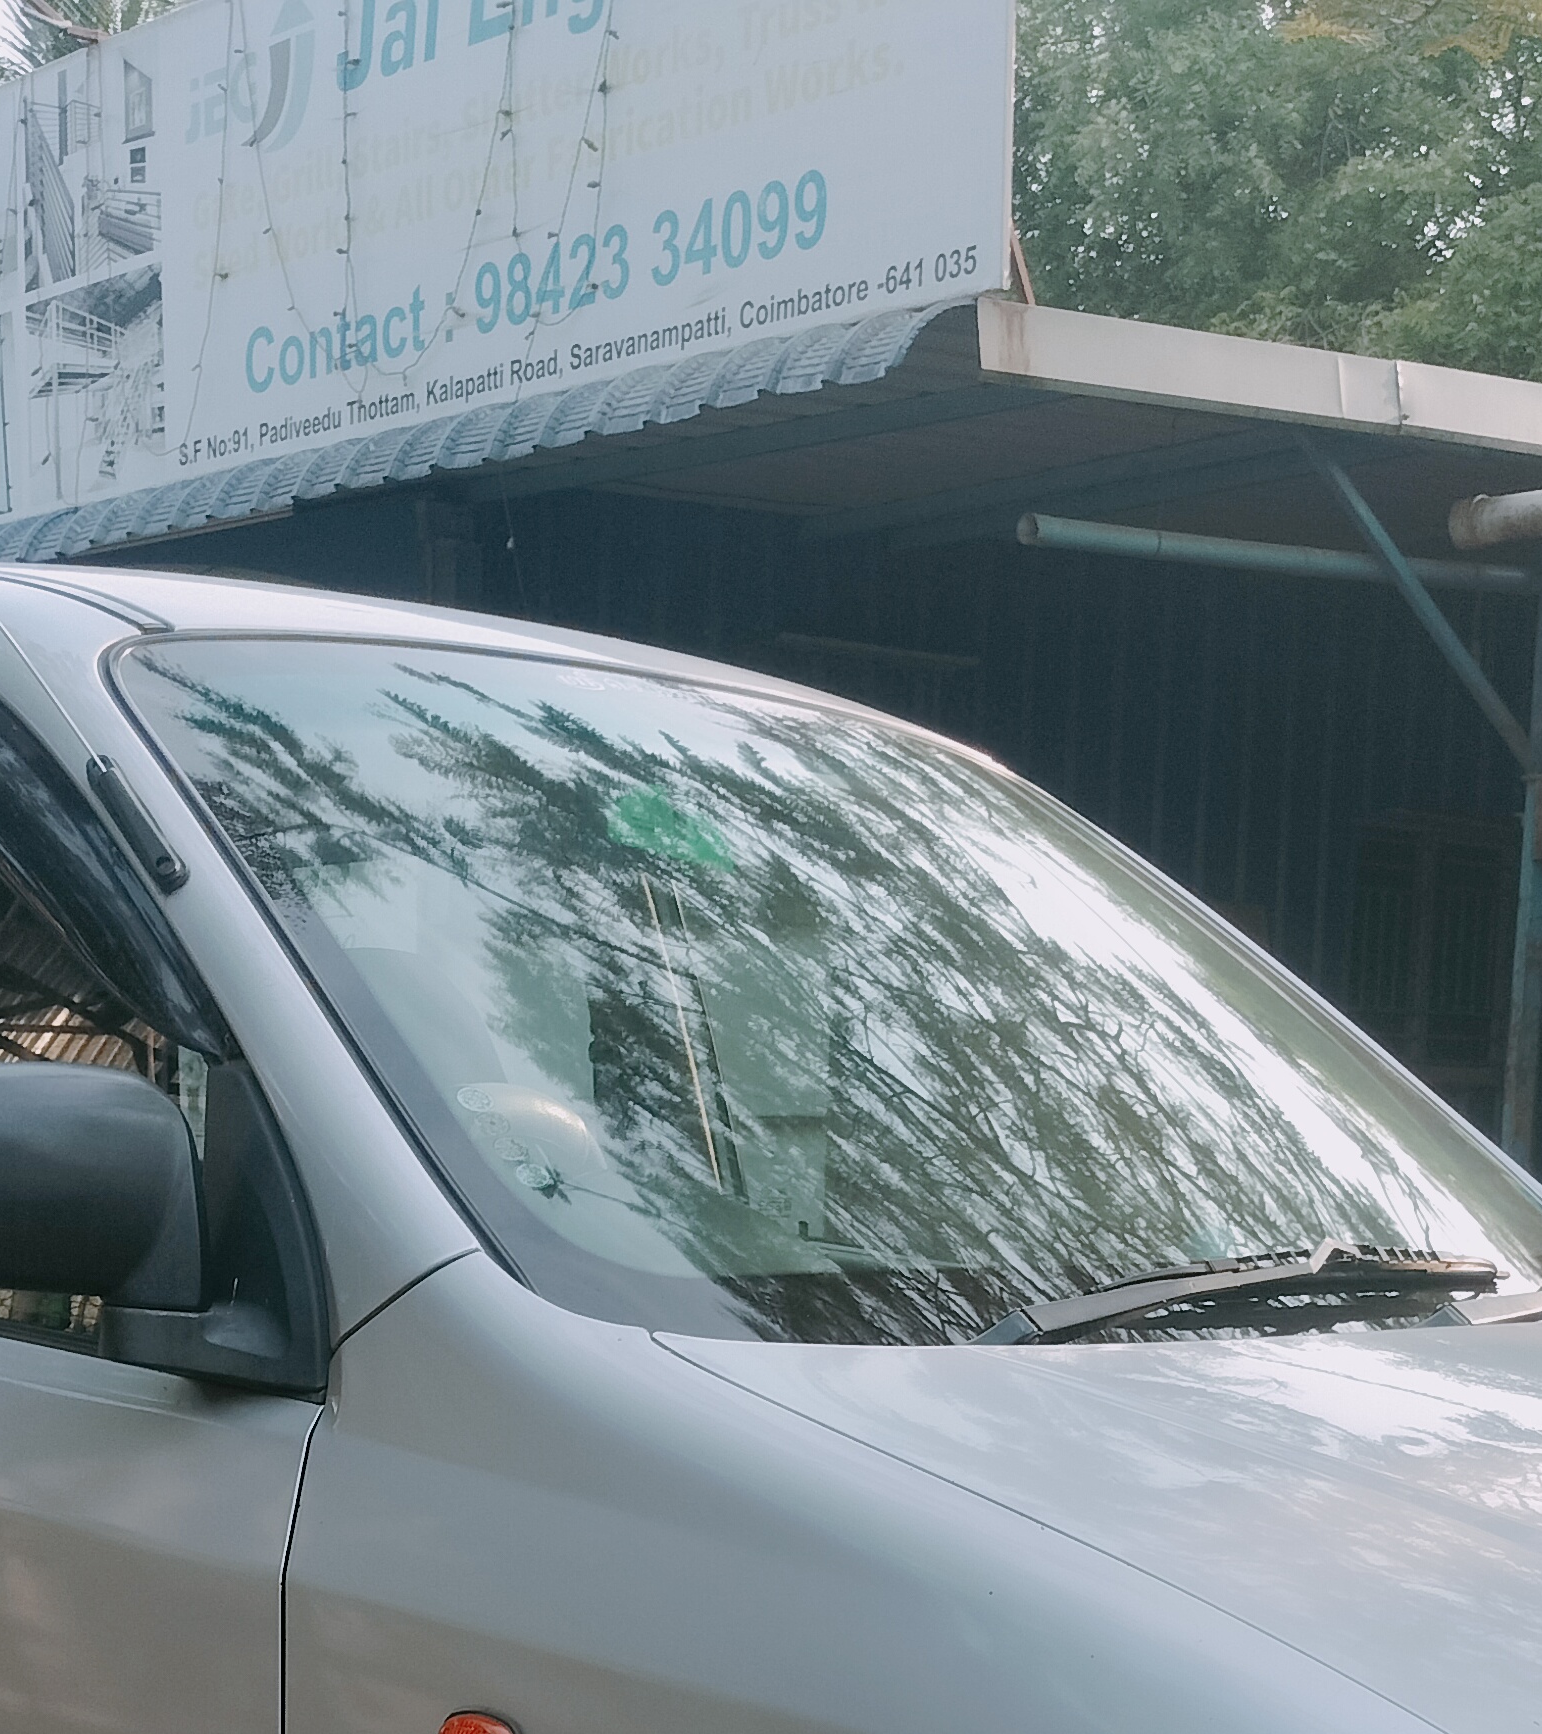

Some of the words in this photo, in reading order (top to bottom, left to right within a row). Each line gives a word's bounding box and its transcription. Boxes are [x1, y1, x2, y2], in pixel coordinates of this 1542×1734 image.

[395, 172, 435, 230] All
[765, 38, 904, 114] Works.
[179, 438, 202, 466] S.F
[207, 427, 255, 460] No:91,
[259, 407, 342, 448] Padiveedu
[347, 391, 421, 424] Thottam,
[426, 363, 504, 406] Kalapatti
[510, 349, 564, 387] Road,
[570, 312, 732, 371] Saravanampatti,
[740, 281, 870, 330] Coimbatore
[935, 244, 978, 283] 035
[245, 284, 425, 393] Contact
[474, 224, 630, 334] 98423
[651, 169, 828, 288] 34099
